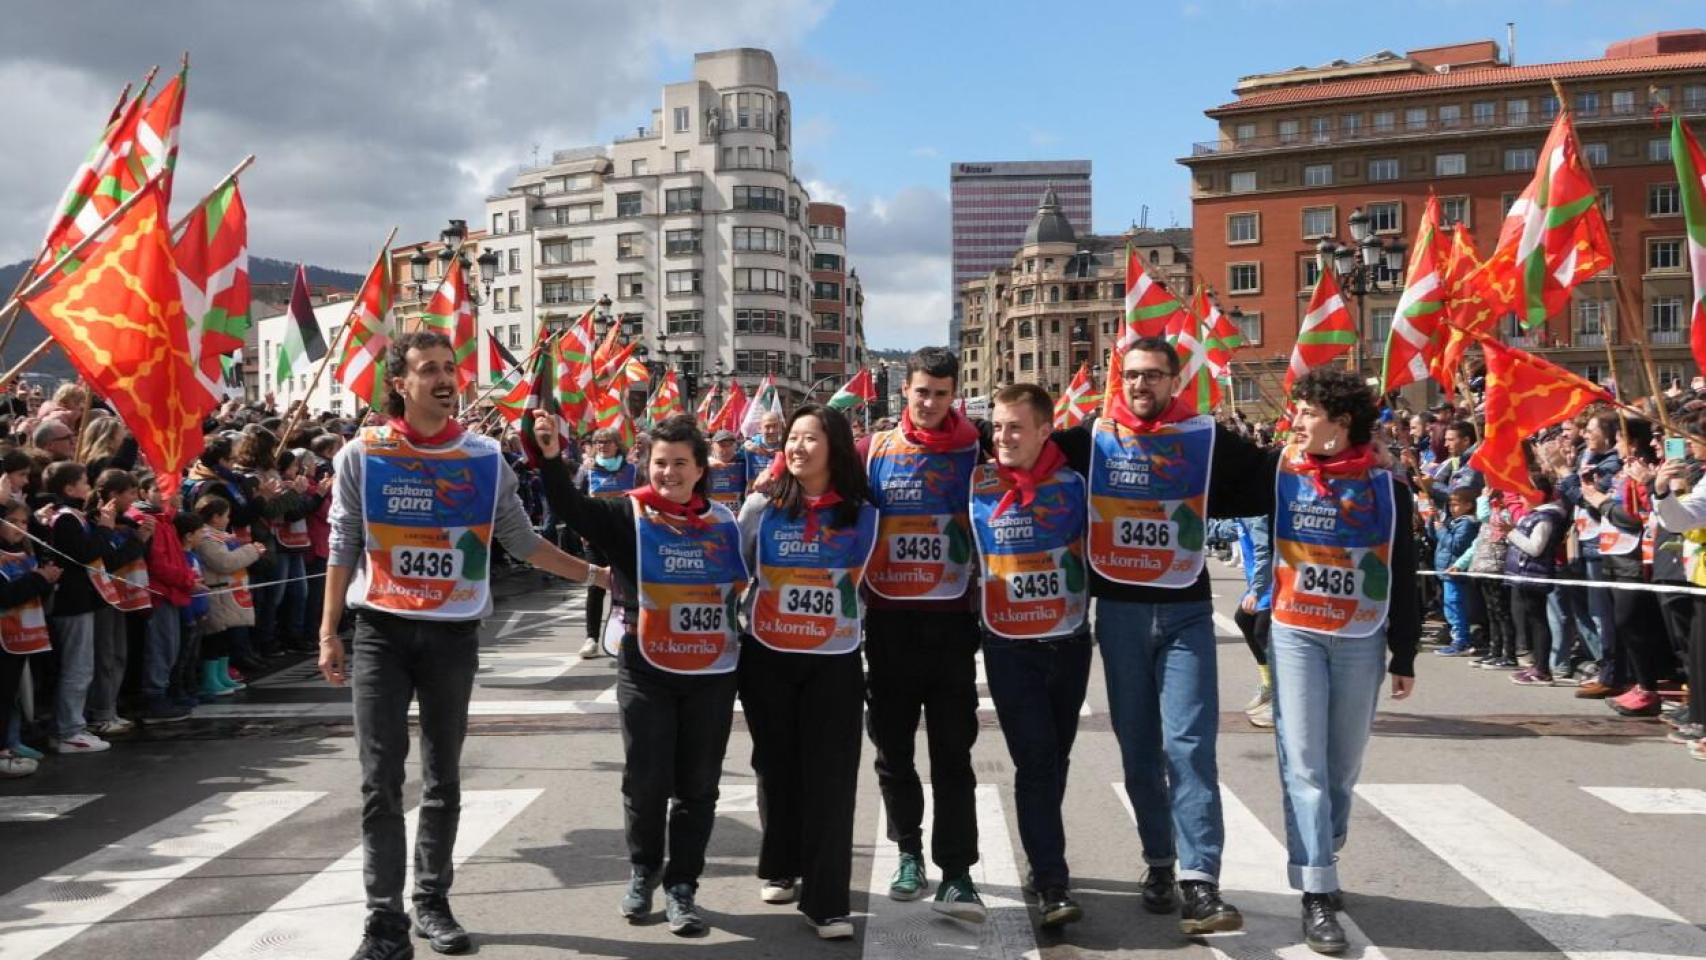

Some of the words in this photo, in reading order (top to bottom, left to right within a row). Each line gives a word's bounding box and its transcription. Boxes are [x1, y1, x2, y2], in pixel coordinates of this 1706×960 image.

[1104, 457, 1150, 472] Euskara
[1109, 469, 1150, 486] gara
[382, 484, 434, 497] Euskara
[885, 488, 922, 504] gara
[387, 496, 434, 513] gara
[1287, 500, 1338, 515] Euskara
[1292, 513, 1337, 531] gara
[994, 525, 1034, 544] gara
[1120, 520, 1170, 546] 3436
[657, 544, 704, 557] Euskara
[778, 541, 820, 557] gara
[895, 537, 942, 561] 3436
[399, 550, 454, 577] 3436
[664, 556, 705, 573] gara
[1092, 551, 1162, 570] 24.korrika
[1012, 572, 1060, 599] 3436
[1302, 565, 1356, 596] 3436
[787, 588, 834, 615] 3436
[679, 607, 723, 632] 3436
[992, 606, 1057, 623] 24.korrika
[758, 617, 828, 637] 24.korrika
[648, 637, 719, 655] 24.korrika
